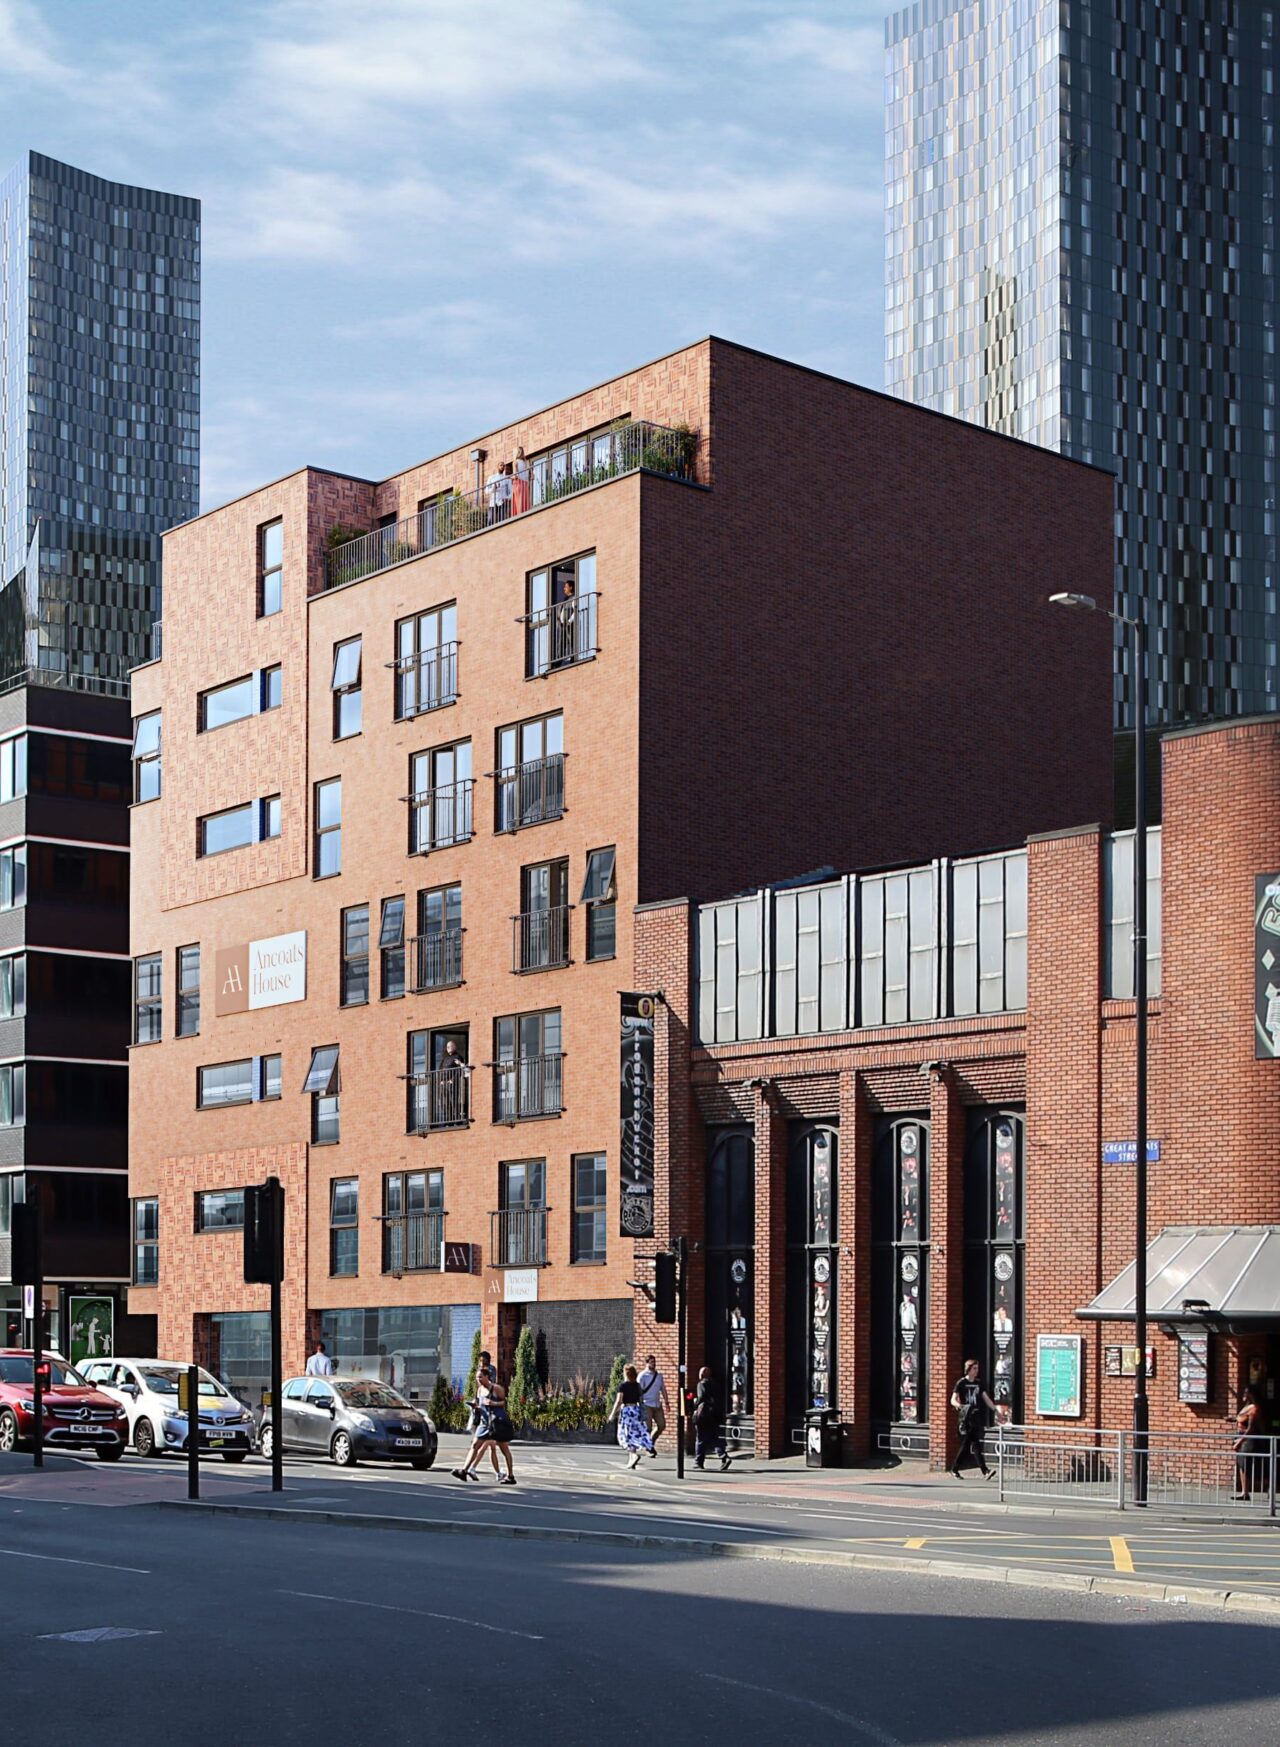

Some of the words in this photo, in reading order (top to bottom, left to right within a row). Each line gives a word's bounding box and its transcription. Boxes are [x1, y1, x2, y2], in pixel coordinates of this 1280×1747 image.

[254, 943, 304, 970] Ancoats
[253, 972, 292, 995] House
[1104, 1143, 1126, 1152] GREAT
[1127, 1141, 1158, 1151] ANATS
